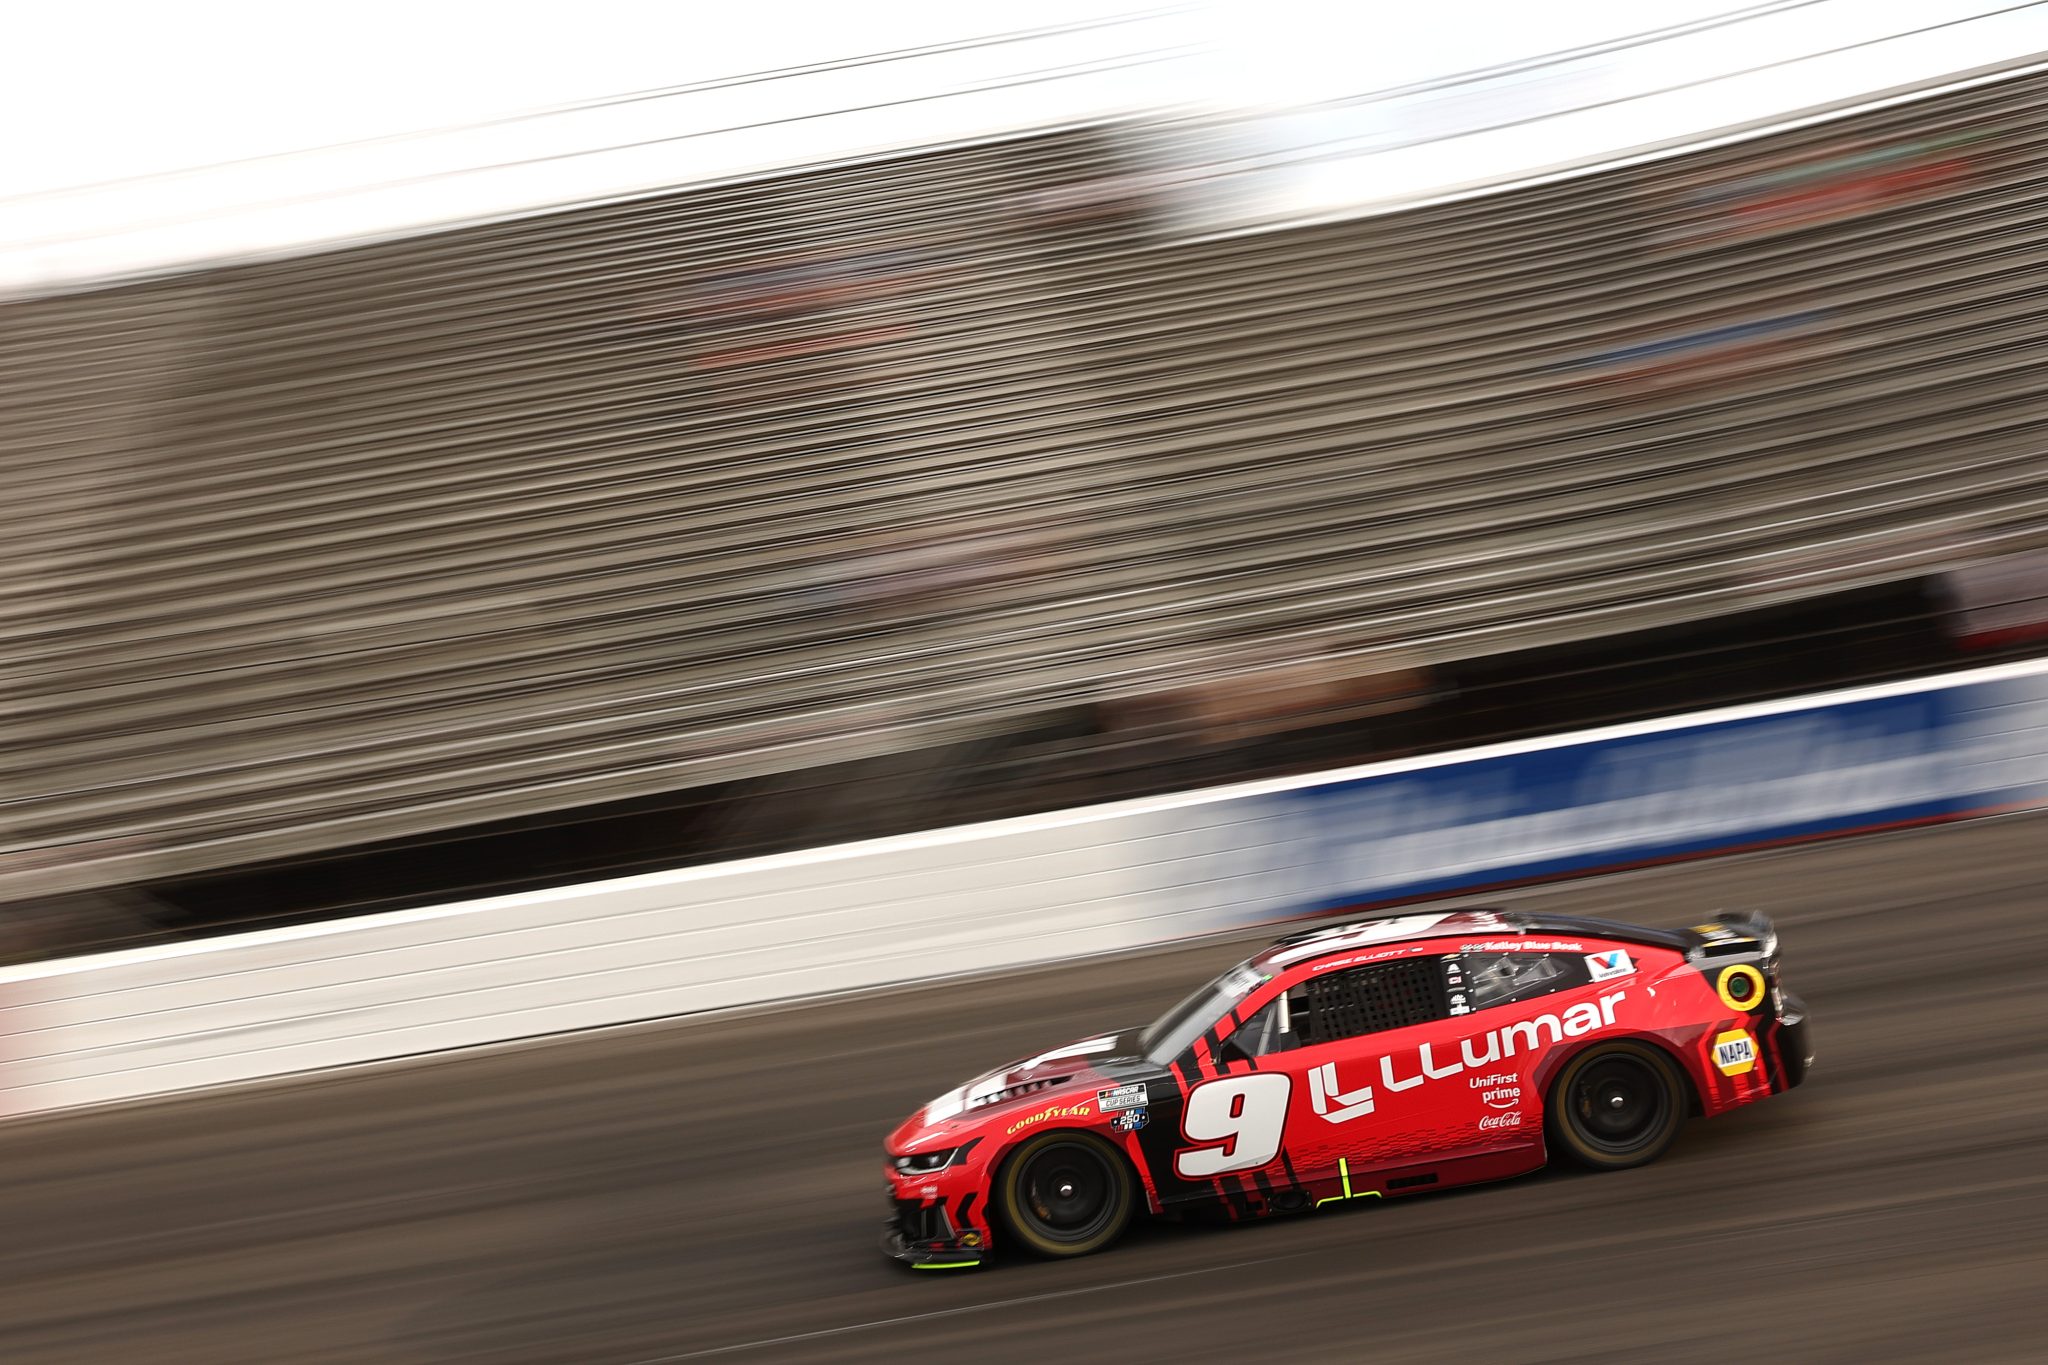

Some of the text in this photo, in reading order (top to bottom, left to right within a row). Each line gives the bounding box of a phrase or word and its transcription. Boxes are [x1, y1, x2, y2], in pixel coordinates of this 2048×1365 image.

[1484, 941, 1582, 952] Kelley Blue Book
[1312, 949, 1406, 971] CHASE ELLIOTT
[1379, 991, 1625, 1093] LLumar
[1719, 1040, 1752, 1064] NAPA
[1469, 1073, 1518, 1089] UniFirst
[1112, 1086, 1139, 1097] NASCAR
[1482, 1087, 1520, 1103] prime
[1106, 1095, 1140, 1107] CUP SERIES
[1006, 1105, 1091, 1135] GOODYEAR
[1120, 1114, 1140, 1126] 250
[1178, 1073, 1291, 1177] 9
